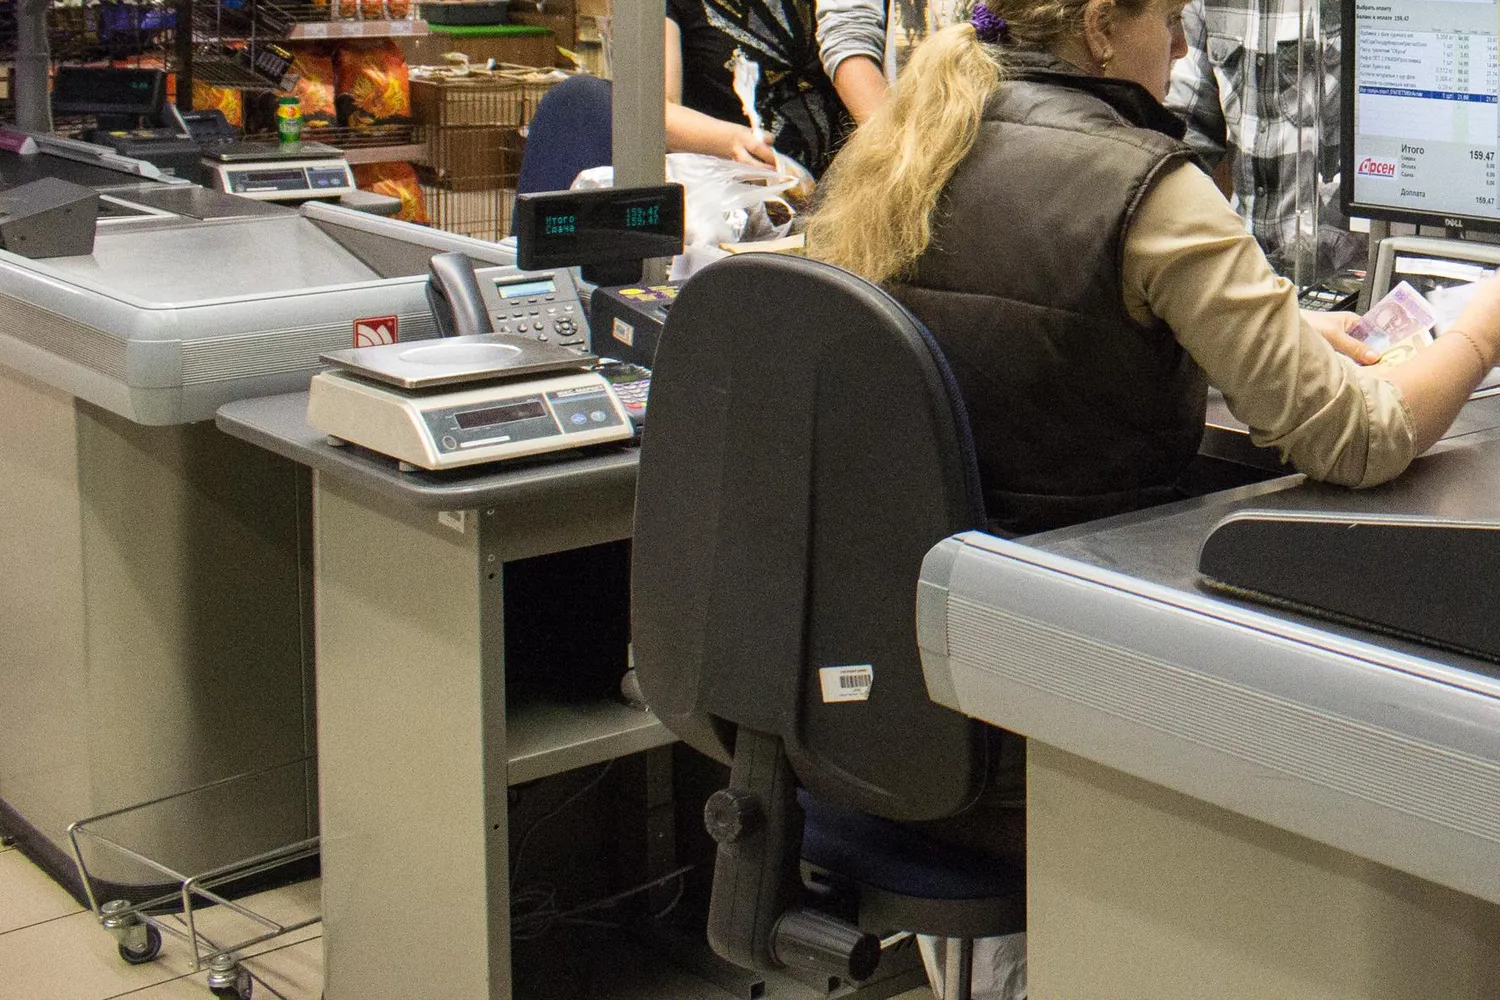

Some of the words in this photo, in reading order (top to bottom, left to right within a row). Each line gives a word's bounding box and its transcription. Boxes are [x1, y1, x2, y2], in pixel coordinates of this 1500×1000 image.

[1401, 143, 1425, 155] Итого
[1470, 150, 1495, 161] 159.47
[1401, 188, 1426, 198] Доплата
